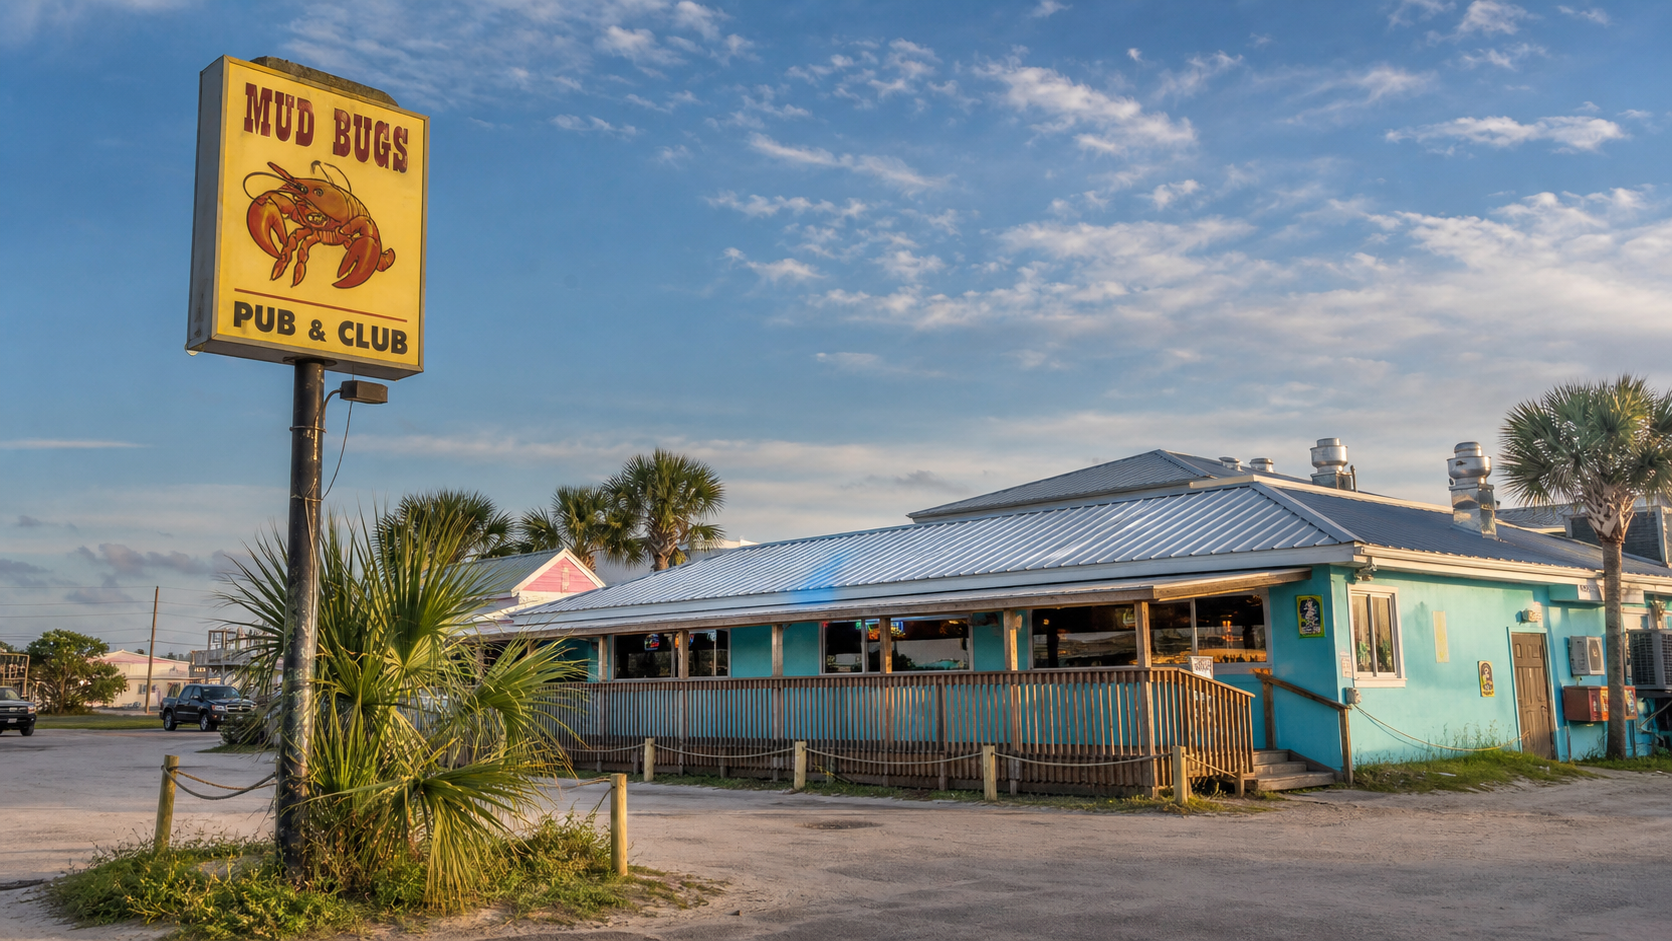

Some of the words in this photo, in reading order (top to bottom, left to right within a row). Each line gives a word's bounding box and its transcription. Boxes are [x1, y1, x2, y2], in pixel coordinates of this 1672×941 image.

[244, 82, 315, 147] MUD
[333, 107, 408, 173] BUGS
[233, 301, 296, 335] PUB
[308, 319, 327, 343] &
[338, 320, 408, 355] CLUB
